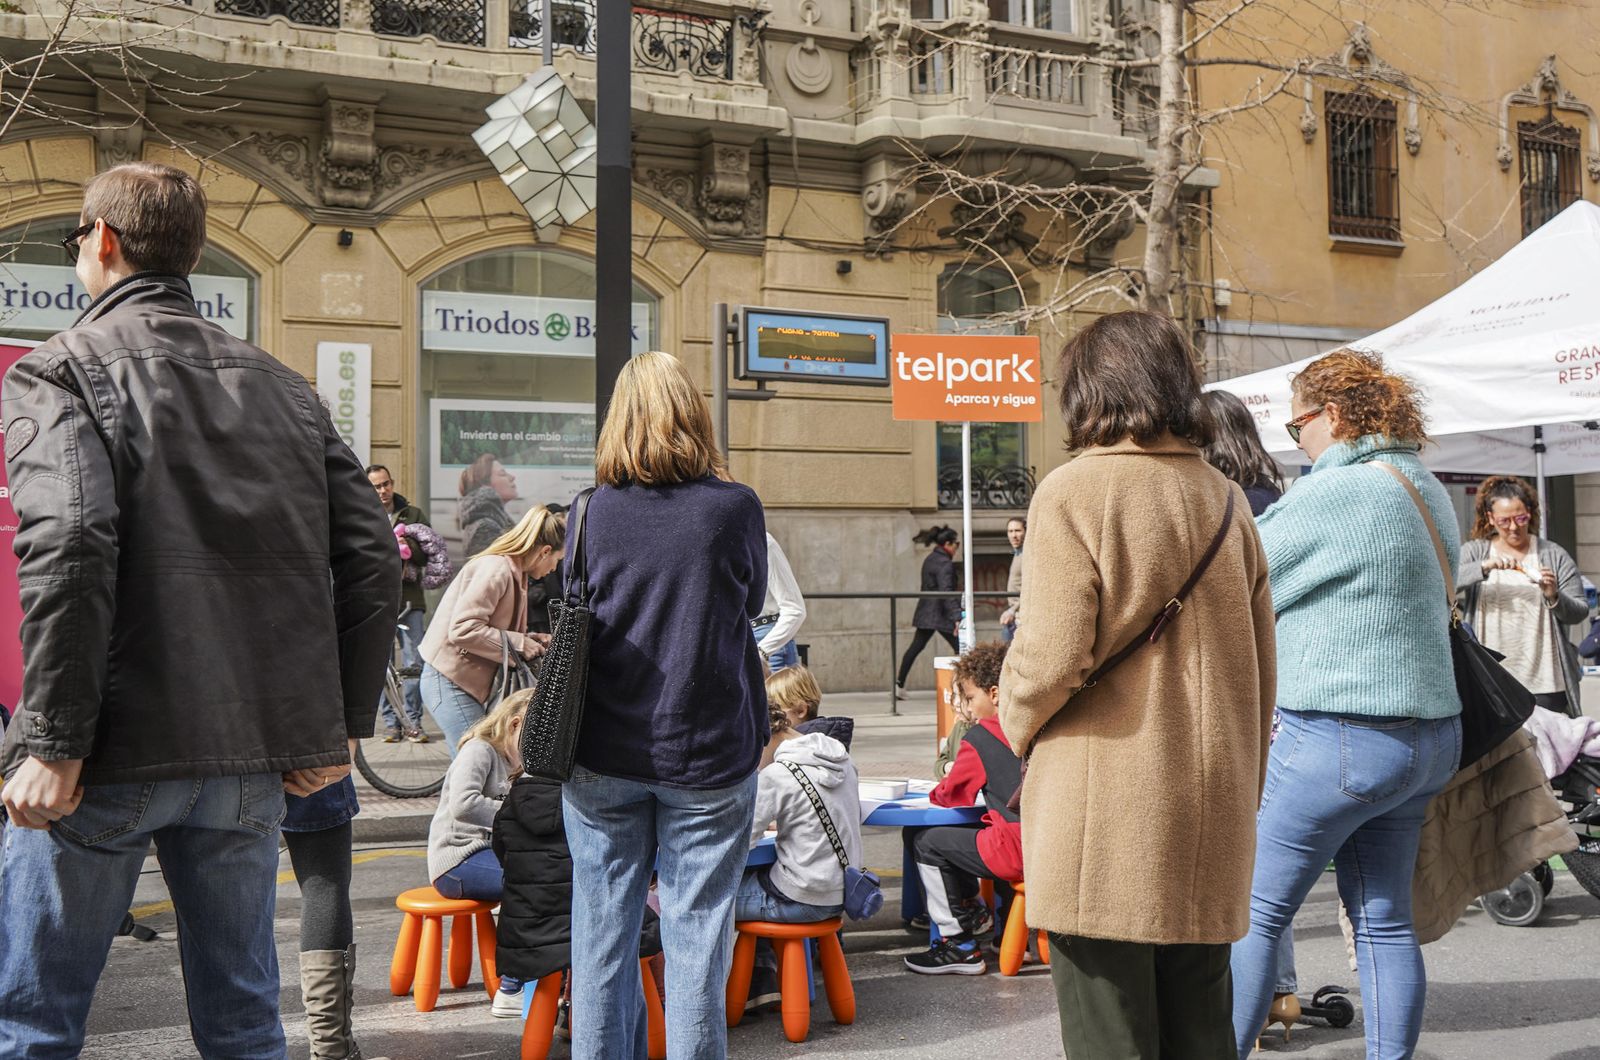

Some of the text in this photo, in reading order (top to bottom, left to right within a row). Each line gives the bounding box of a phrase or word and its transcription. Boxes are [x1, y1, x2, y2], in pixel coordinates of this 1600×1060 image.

[0, 281, 93, 311] riodo
[435, 308, 540, 336] Triodos
[896, 352, 1035, 389] telpark
[945, 393, 1036, 407] Aparca y sigue
[460, 430, 499, 441] Invierte
[500, 431, 513, 441] en
[514, 431, 524, 441] el
[525, 431, 562, 442] cambio
[794, 769, 824, 811] SPORT
[819, 808, 842, 850] SPORT
